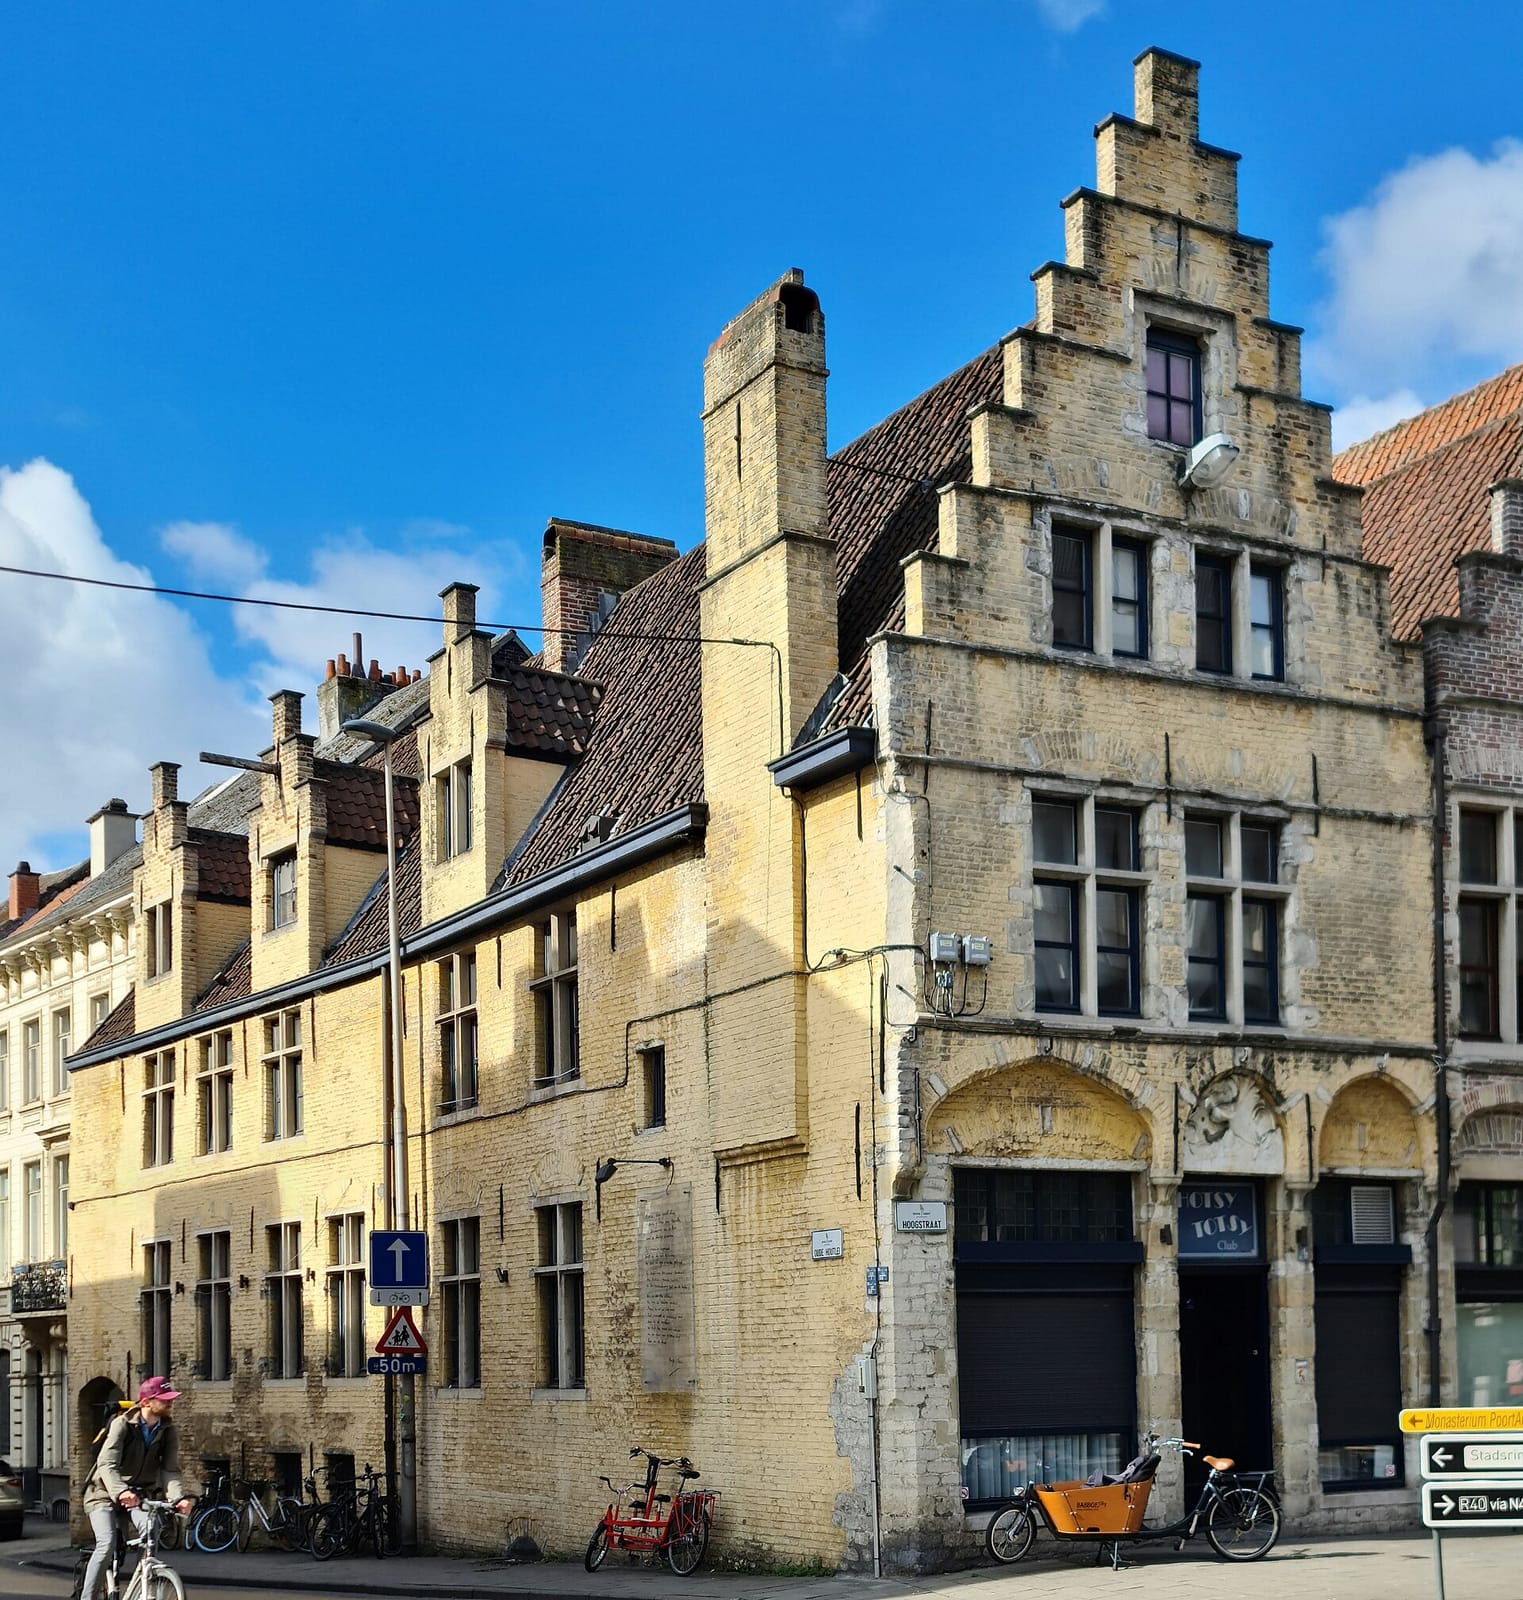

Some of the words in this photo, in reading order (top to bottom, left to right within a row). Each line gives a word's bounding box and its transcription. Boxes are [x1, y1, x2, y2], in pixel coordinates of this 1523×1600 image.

[1176, 1191, 1238, 1209] HOTSY
[902, 1220, 941, 1229] HOOGSTRAAT
[1192, 1214, 1252, 1238] TOTSY
[1217, 1240, 1239, 1250] Club
[1425, 1413, 1487, 1429] Monasterium
[1489, 1411, 1523, 1428] PoortA
[1460, 1498, 1486, 1511] R40
[1489, 1498, 1508, 1511] via
